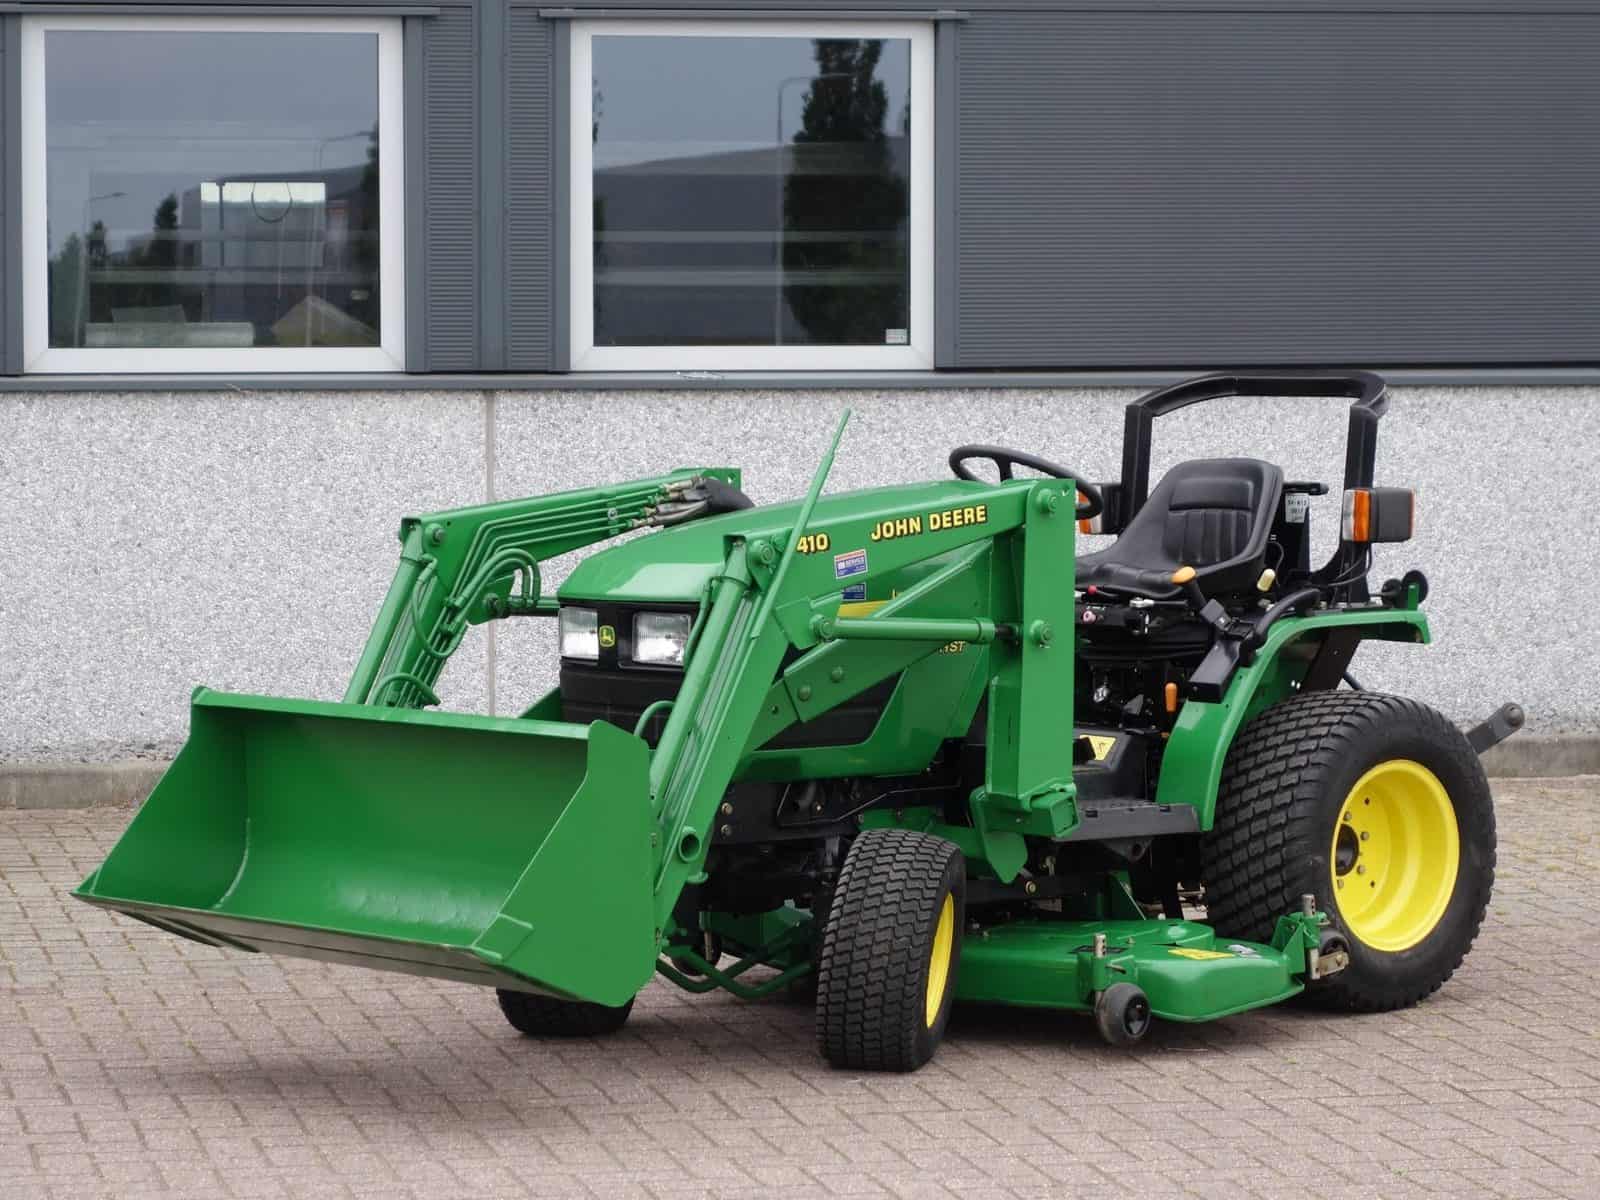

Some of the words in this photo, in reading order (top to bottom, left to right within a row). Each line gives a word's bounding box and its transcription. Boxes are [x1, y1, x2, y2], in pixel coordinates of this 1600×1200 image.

[871, 516, 922, 541] JOHN
[928, 505, 987, 531] DEERE
[796, 532, 830, 554] 410
